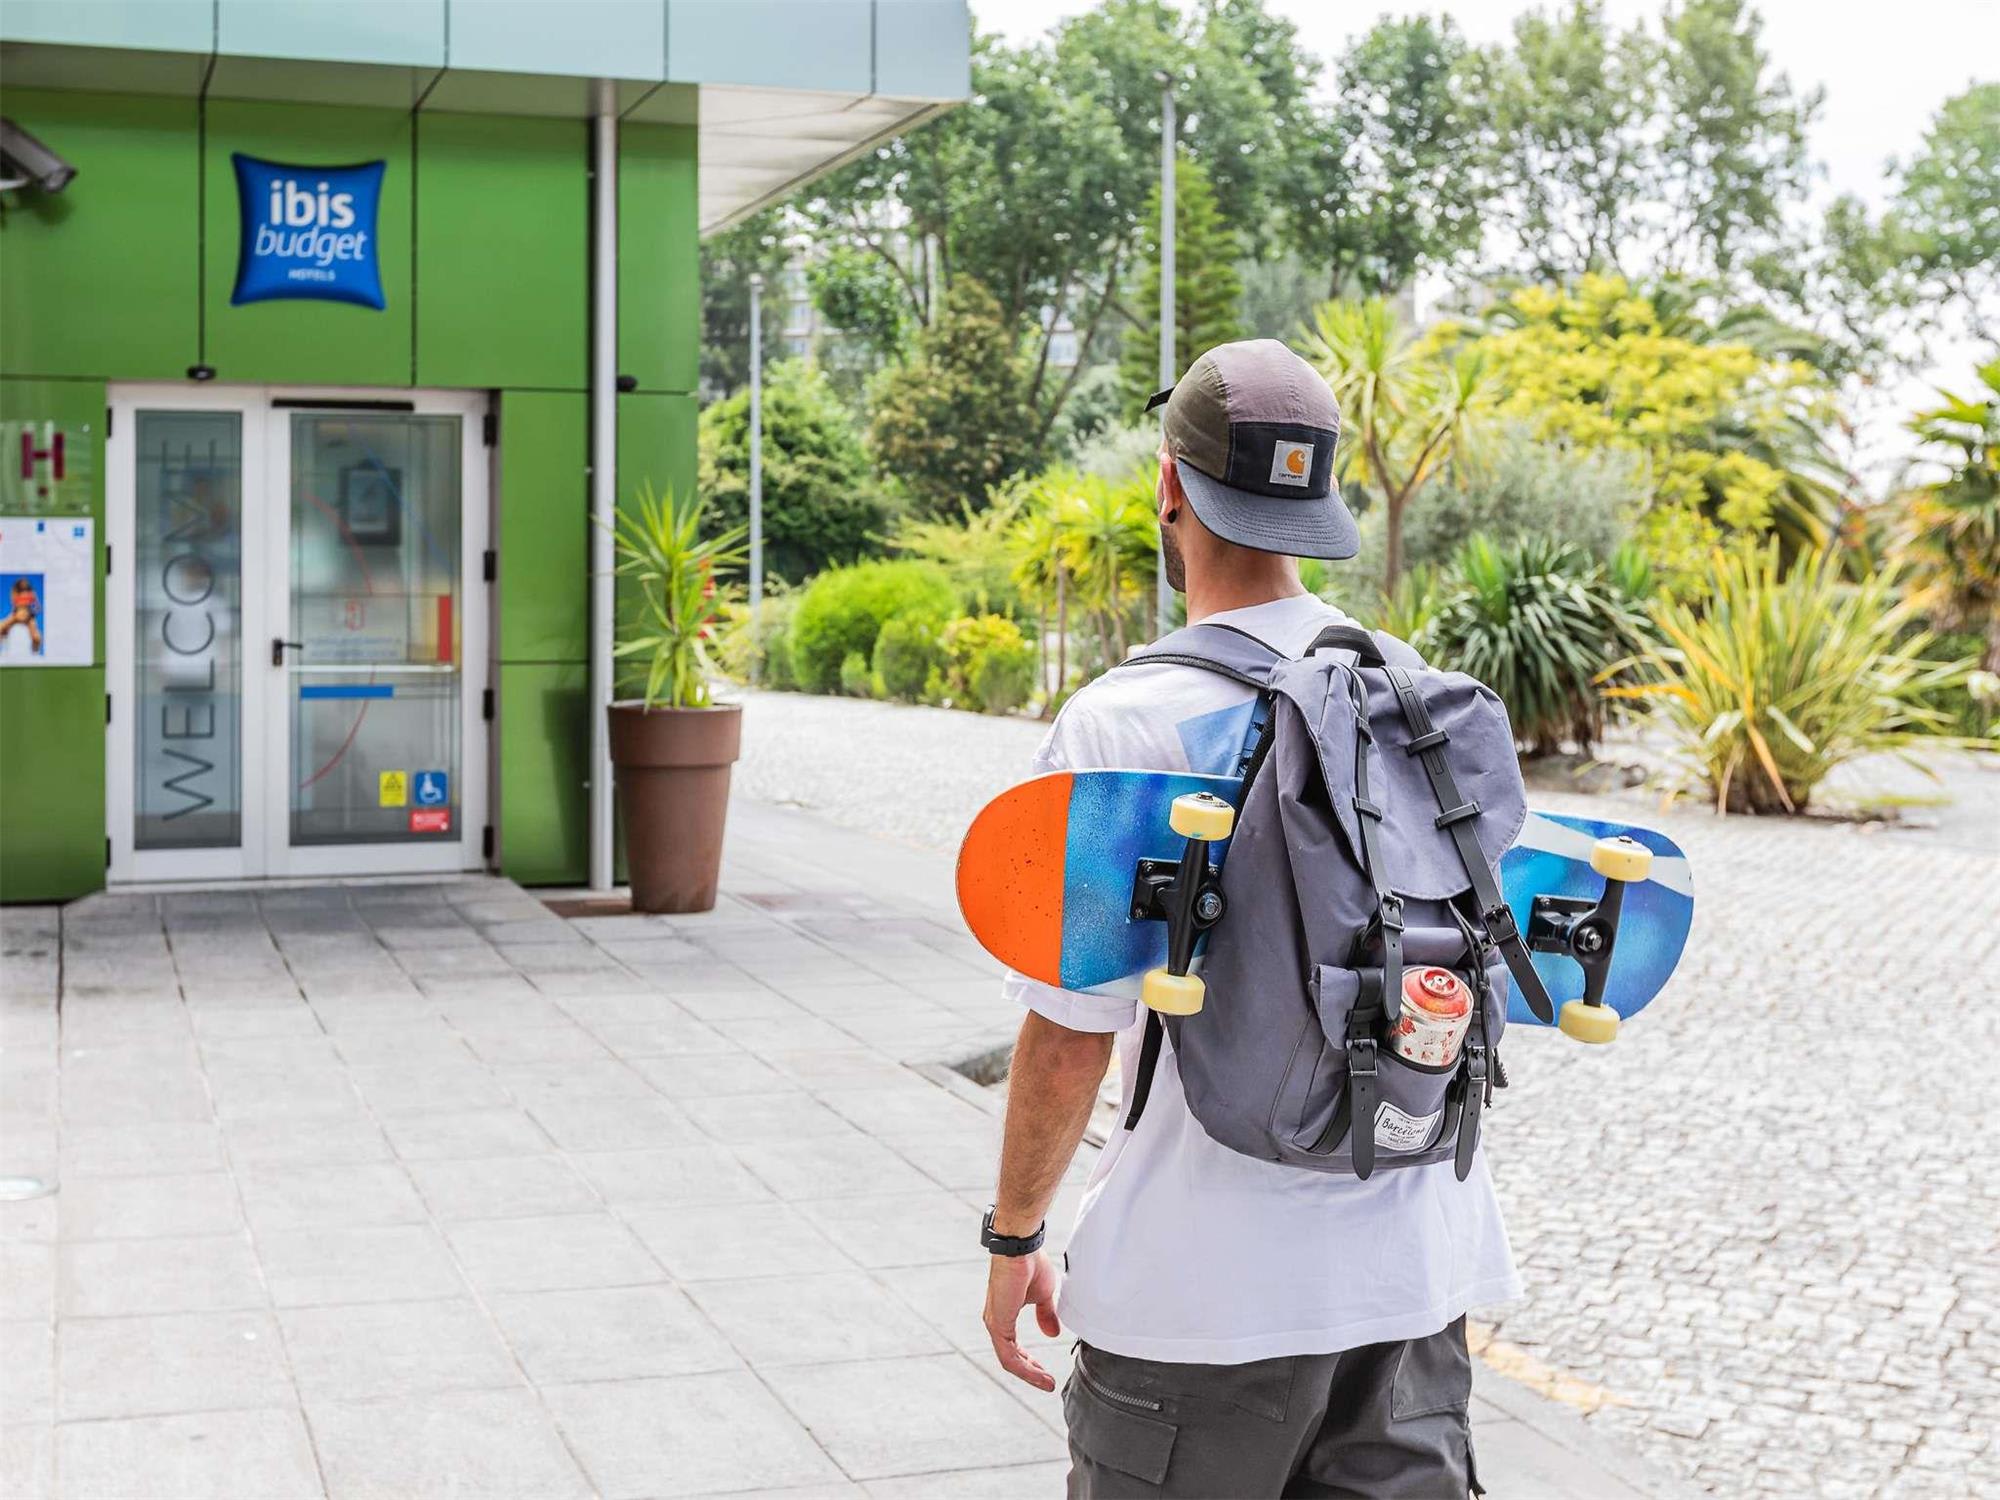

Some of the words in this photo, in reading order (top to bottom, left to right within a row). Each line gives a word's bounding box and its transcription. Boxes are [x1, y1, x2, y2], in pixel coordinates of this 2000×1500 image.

[270, 180, 355, 228] ibis
[255, 225, 367, 266] budget
[21, 431, 64, 480] H
[162, 439, 215, 821] WELCOME
